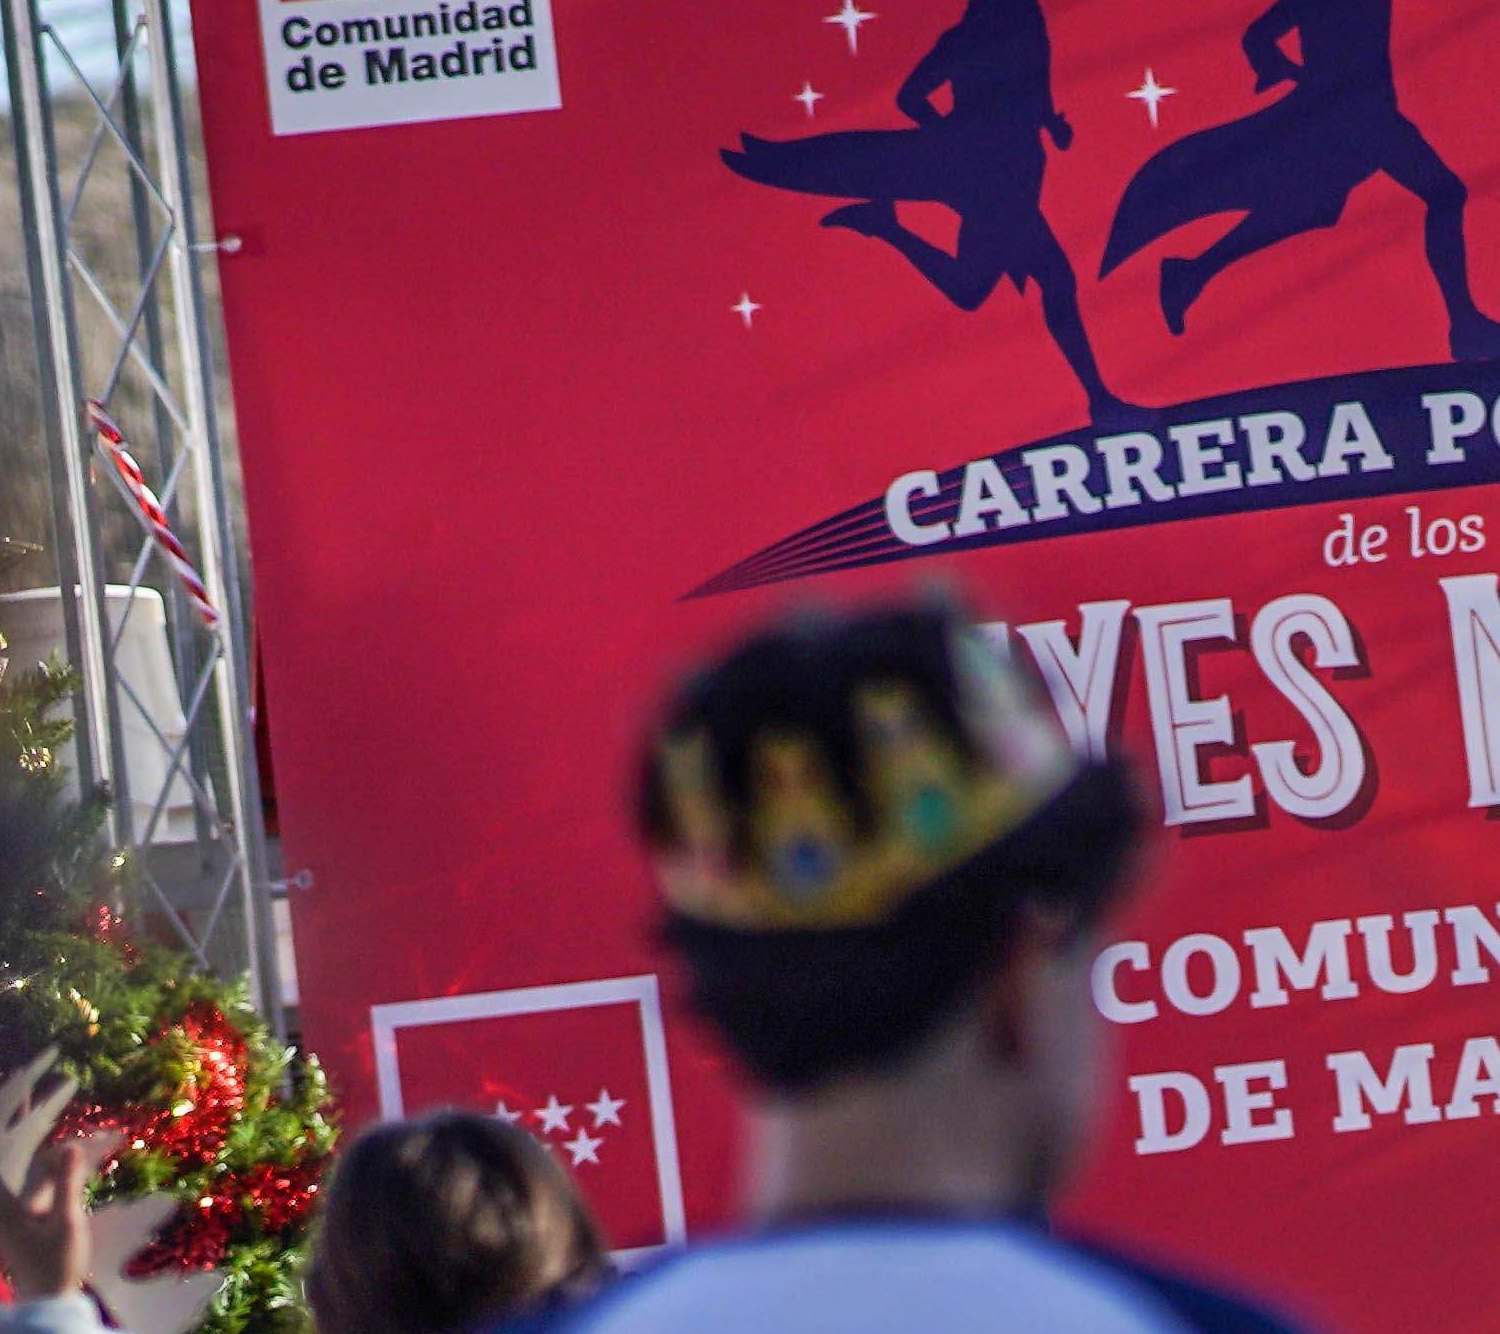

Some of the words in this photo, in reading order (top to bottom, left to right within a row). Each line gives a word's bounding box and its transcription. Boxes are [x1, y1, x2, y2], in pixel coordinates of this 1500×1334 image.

[286, 56, 346, 93] de
[364, 35, 538, 86] Madrid
[883, 400, 1395, 547] CARRERA
[1323, 513, 1388, 568] de
[1405, 506, 1487, 559] los
[976, 593, 1366, 827] YES
[1128, 1060, 1295, 1156] DE
